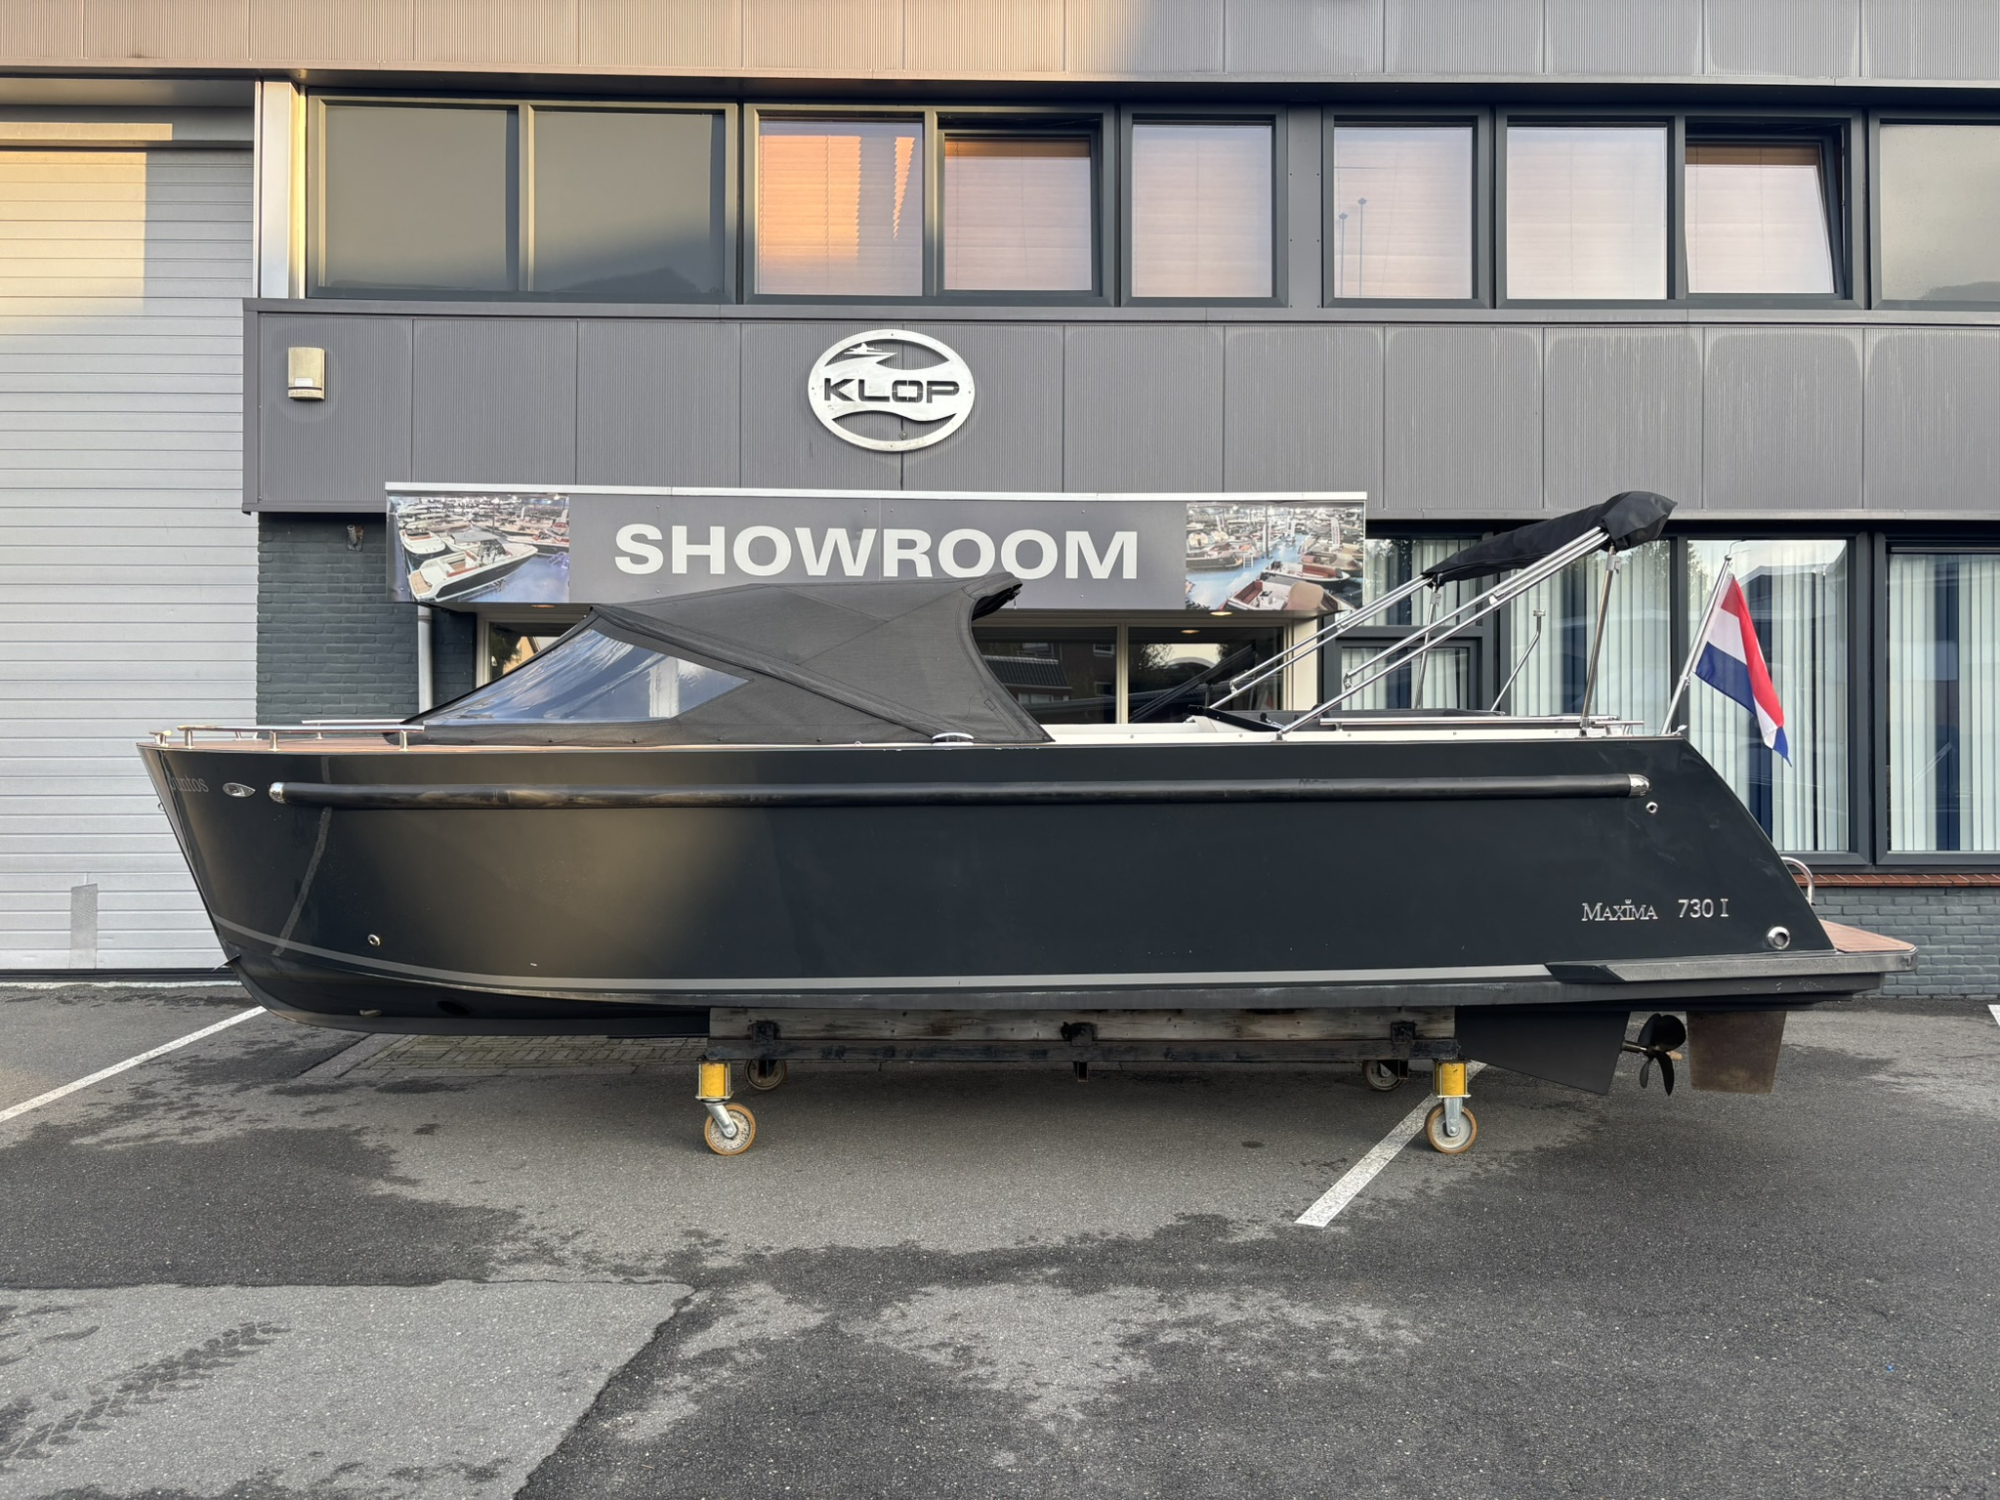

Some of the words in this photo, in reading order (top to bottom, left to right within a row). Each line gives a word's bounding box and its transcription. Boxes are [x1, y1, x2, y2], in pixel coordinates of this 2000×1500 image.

[824, 377, 960, 404] KLOP
[614, 523, 1139, 580] SHOWROOM
[1581, 901, 1659, 921] MAXIMA
[1677, 898, 1714, 918] 730
[1719, 898, 1730, 918] I
